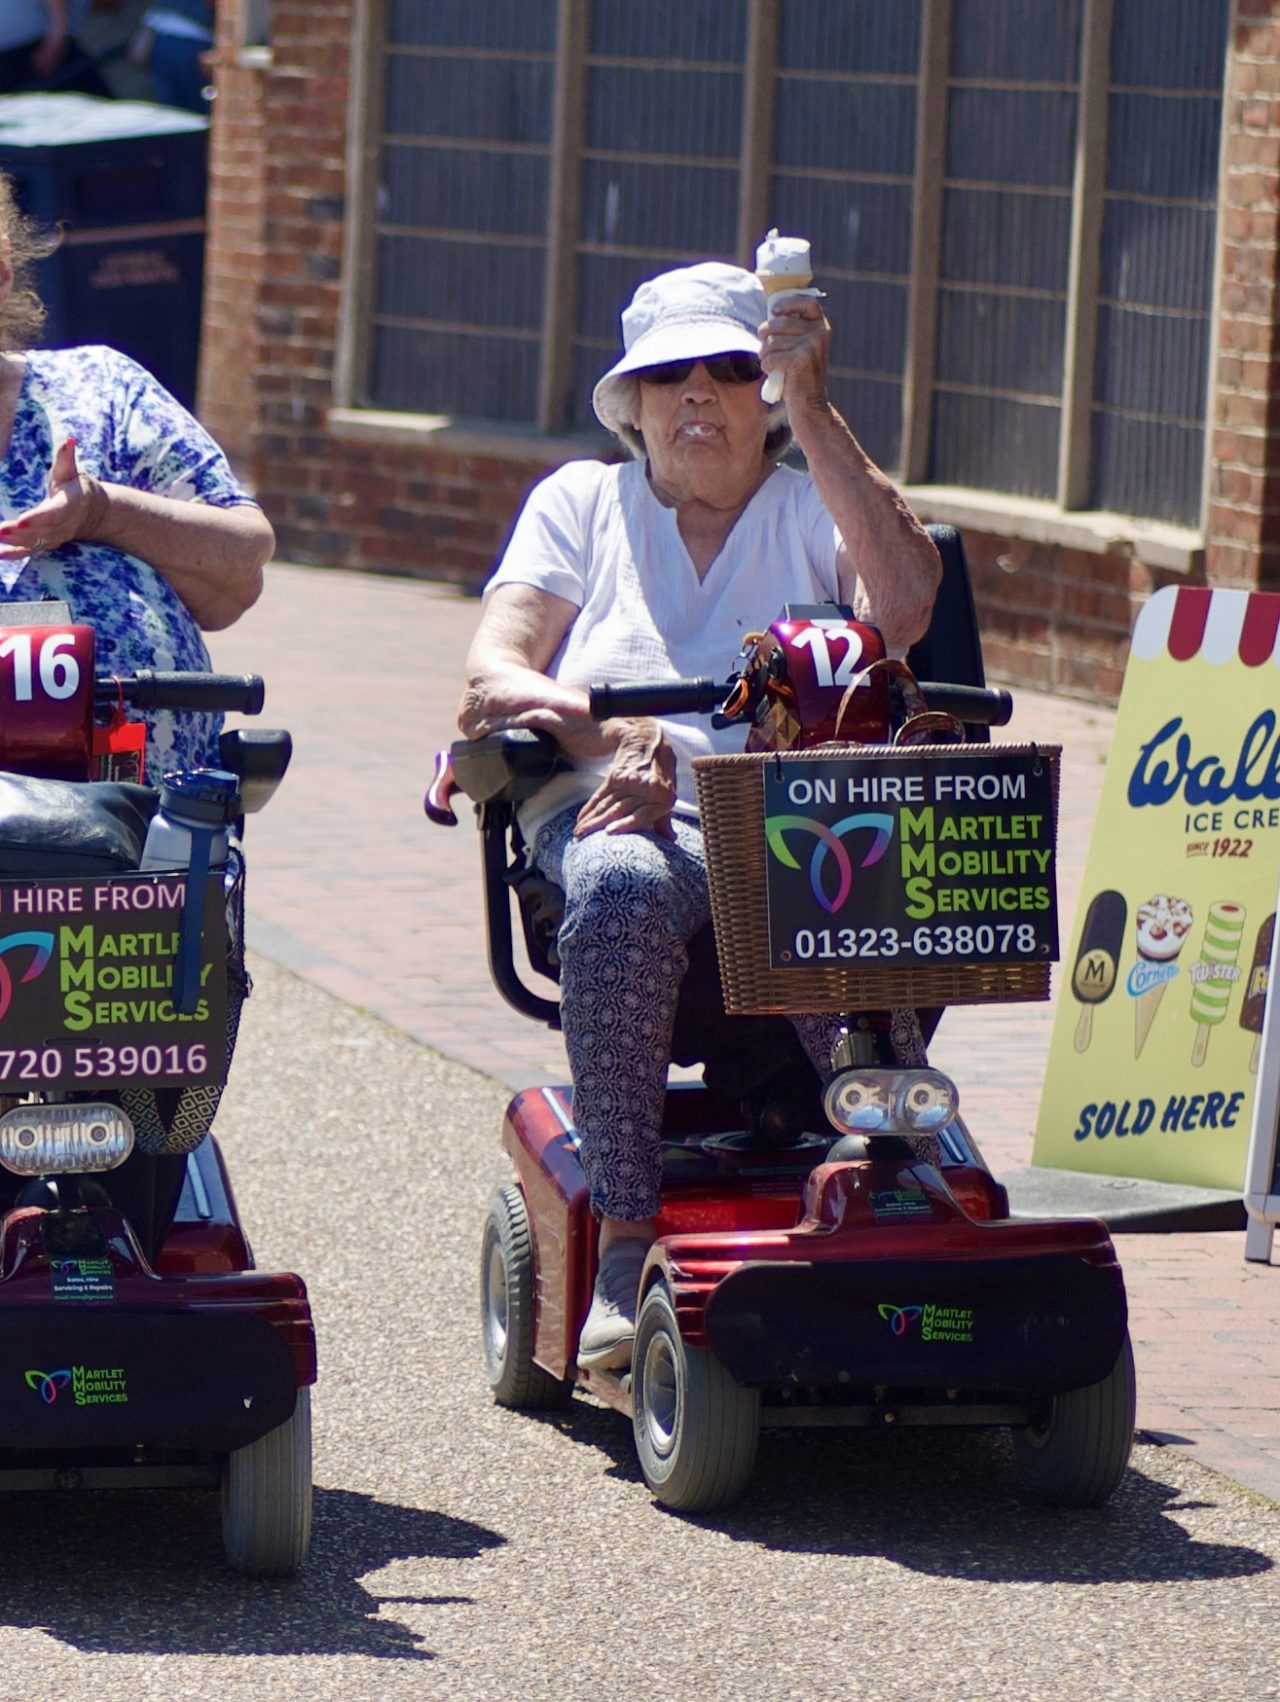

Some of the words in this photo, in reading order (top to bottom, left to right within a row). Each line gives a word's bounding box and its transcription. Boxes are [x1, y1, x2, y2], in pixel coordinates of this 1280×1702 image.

[791, 626, 871, 688] 12
[787, 778, 837, 804] ON
[847, 775, 924, 803] HIRE
[934, 773, 1026, 801] FROM
[899, 806, 1043, 842] MARTLET
[1184, 812, 1223, 833] ICE
[901, 842, 1052, 878] MOBILITY
[1211, 837, 1253, 858] 1922
[13, 886, 83, 914] HIRE
[94, 883, 186, 912] FROM
[904, 876, 1051, 920] SERVICES
[795, 924, 1037, 960] 01323-638078
[60, 959, 213, 992] MOBILIY
[63, 990, 210, 1031] SERVICS
[74, 1044, 208, 1077] 539016
[1074, 1098, 1156, 1142] SOLD
[1160, 1091, 1246, 1133] HERE
[72, 1366, 124, 1379] MARTLET
[73, 1379, 126, 1392] MOBILITY
[75, 1391, 128, 1405] SERVICES
